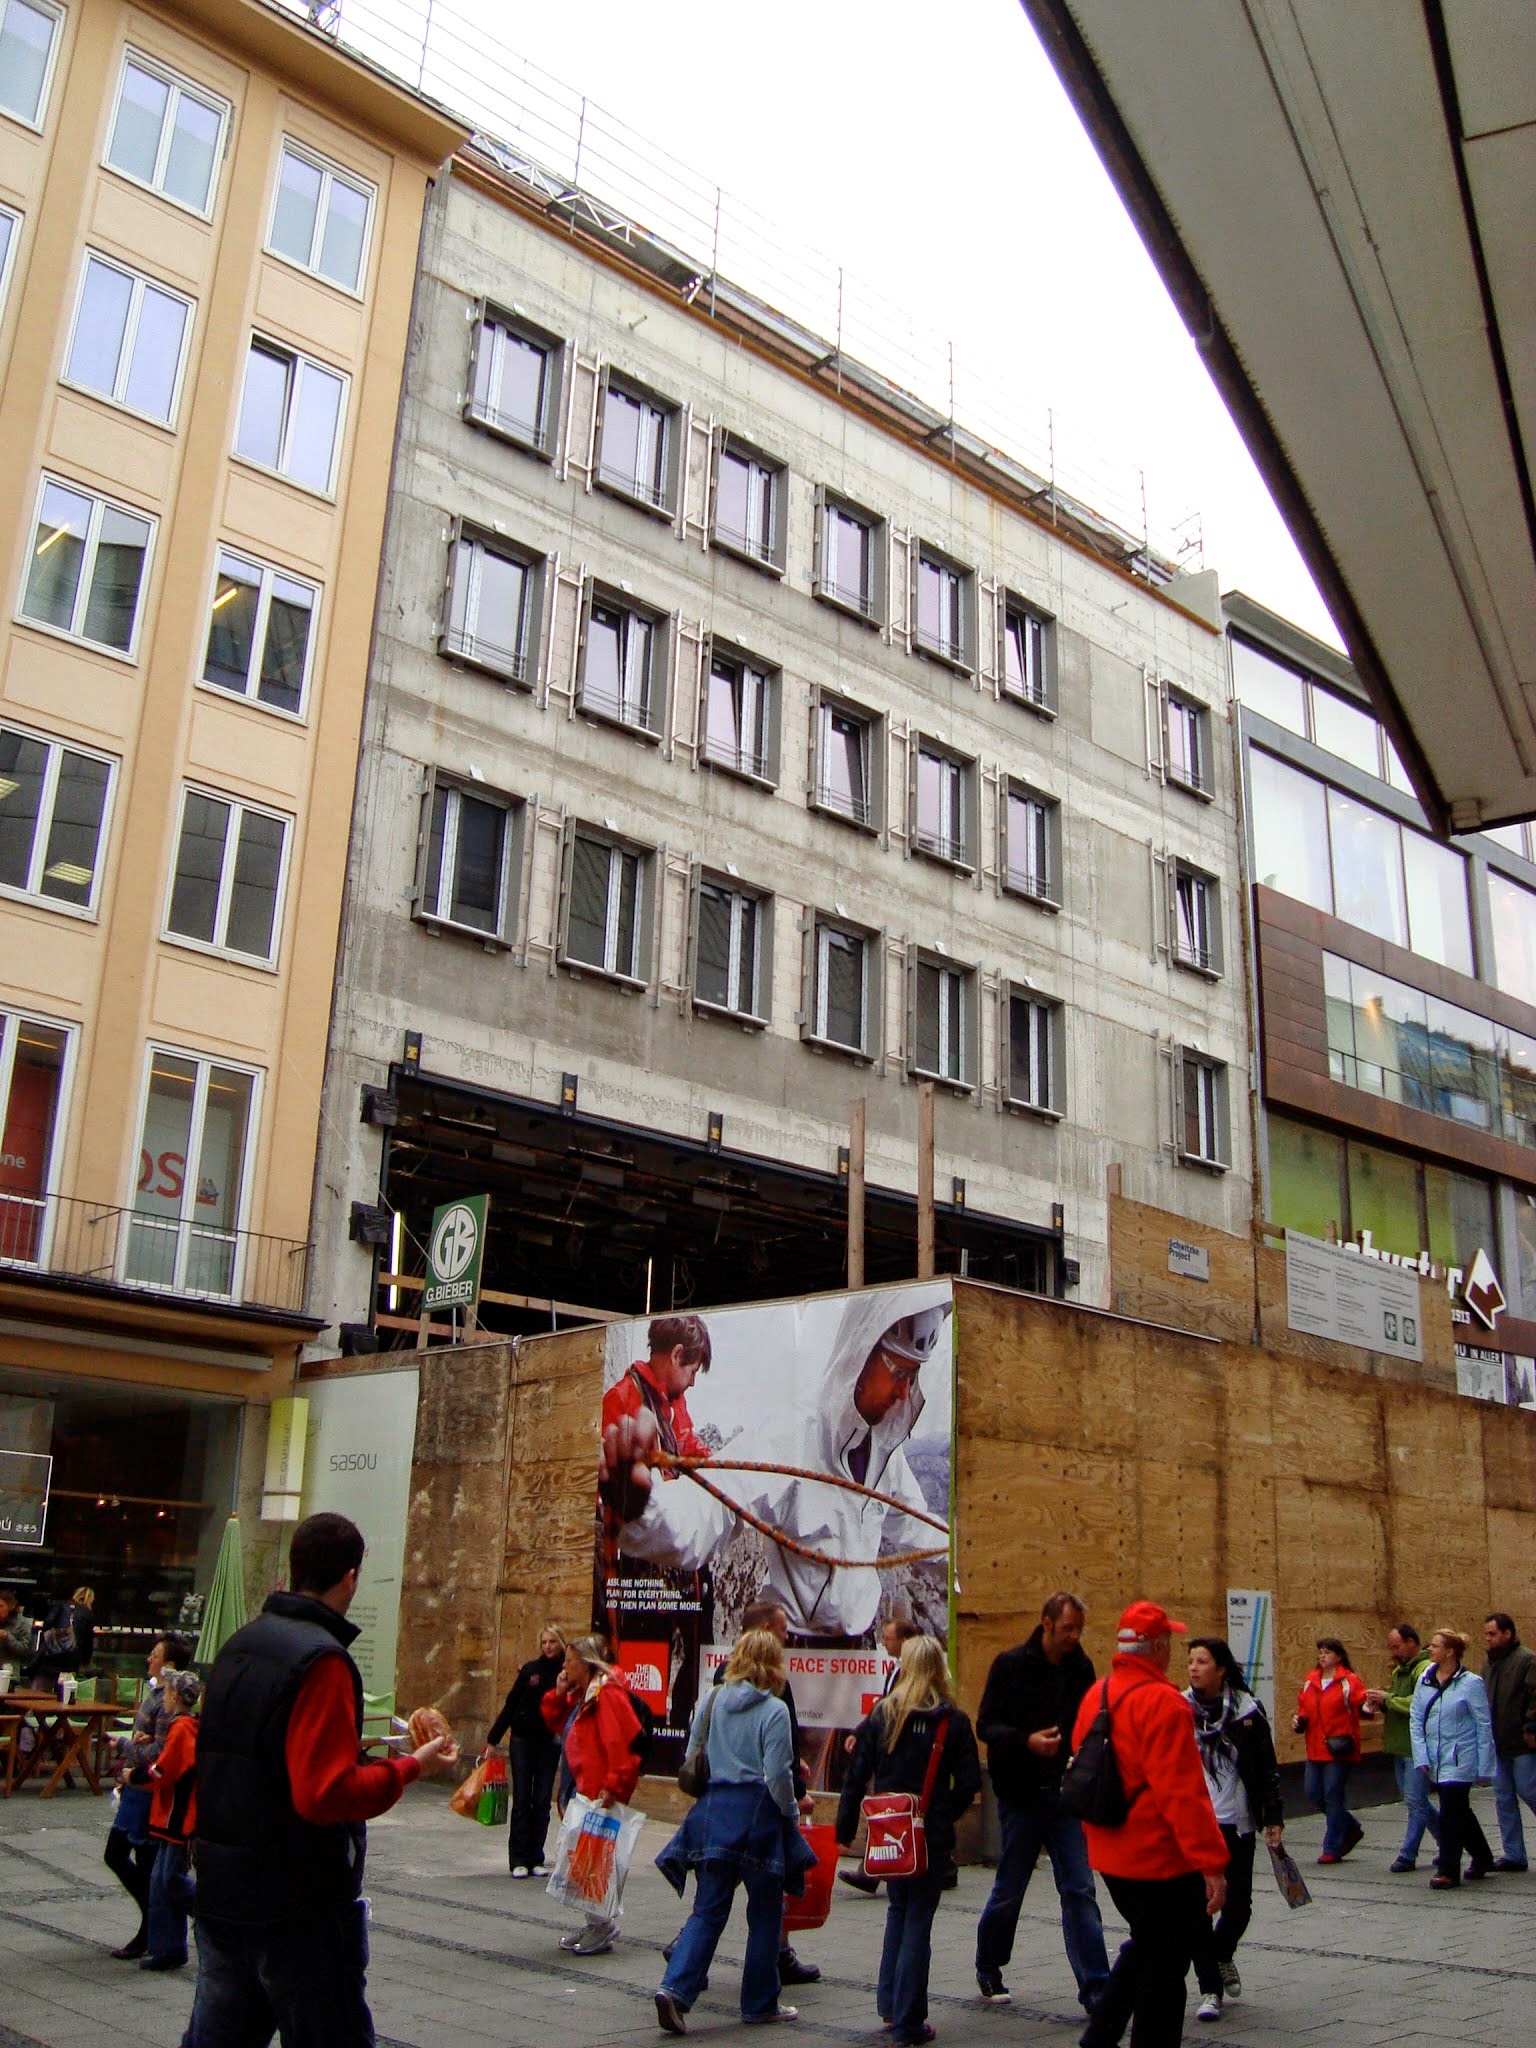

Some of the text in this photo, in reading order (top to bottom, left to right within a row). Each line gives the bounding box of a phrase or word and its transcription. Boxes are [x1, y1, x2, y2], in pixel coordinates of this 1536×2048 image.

[426, 1280, 473, 1302] G.BIEBER
[329, 1453, 377, 1471] sasou
[634, 1578, 666, 1588] NOTHING.
[623, 1590, 637, 1599] FOR
[638, 1590, 682, 1600] EVERYTHING.
[606, 1600, 702, 1611] AND THEN PLAN SOME MORE.
[635, 1664, 650, 1673] THE
[789, 1657, 825, 1673] FACE
[830, 1659, 877, 1675] STORE
[624, 1672, 650, 1682] NORTH
[630, 1681, 650, 1691] FACE
[868, 1845, 898, 1860] PUMA
